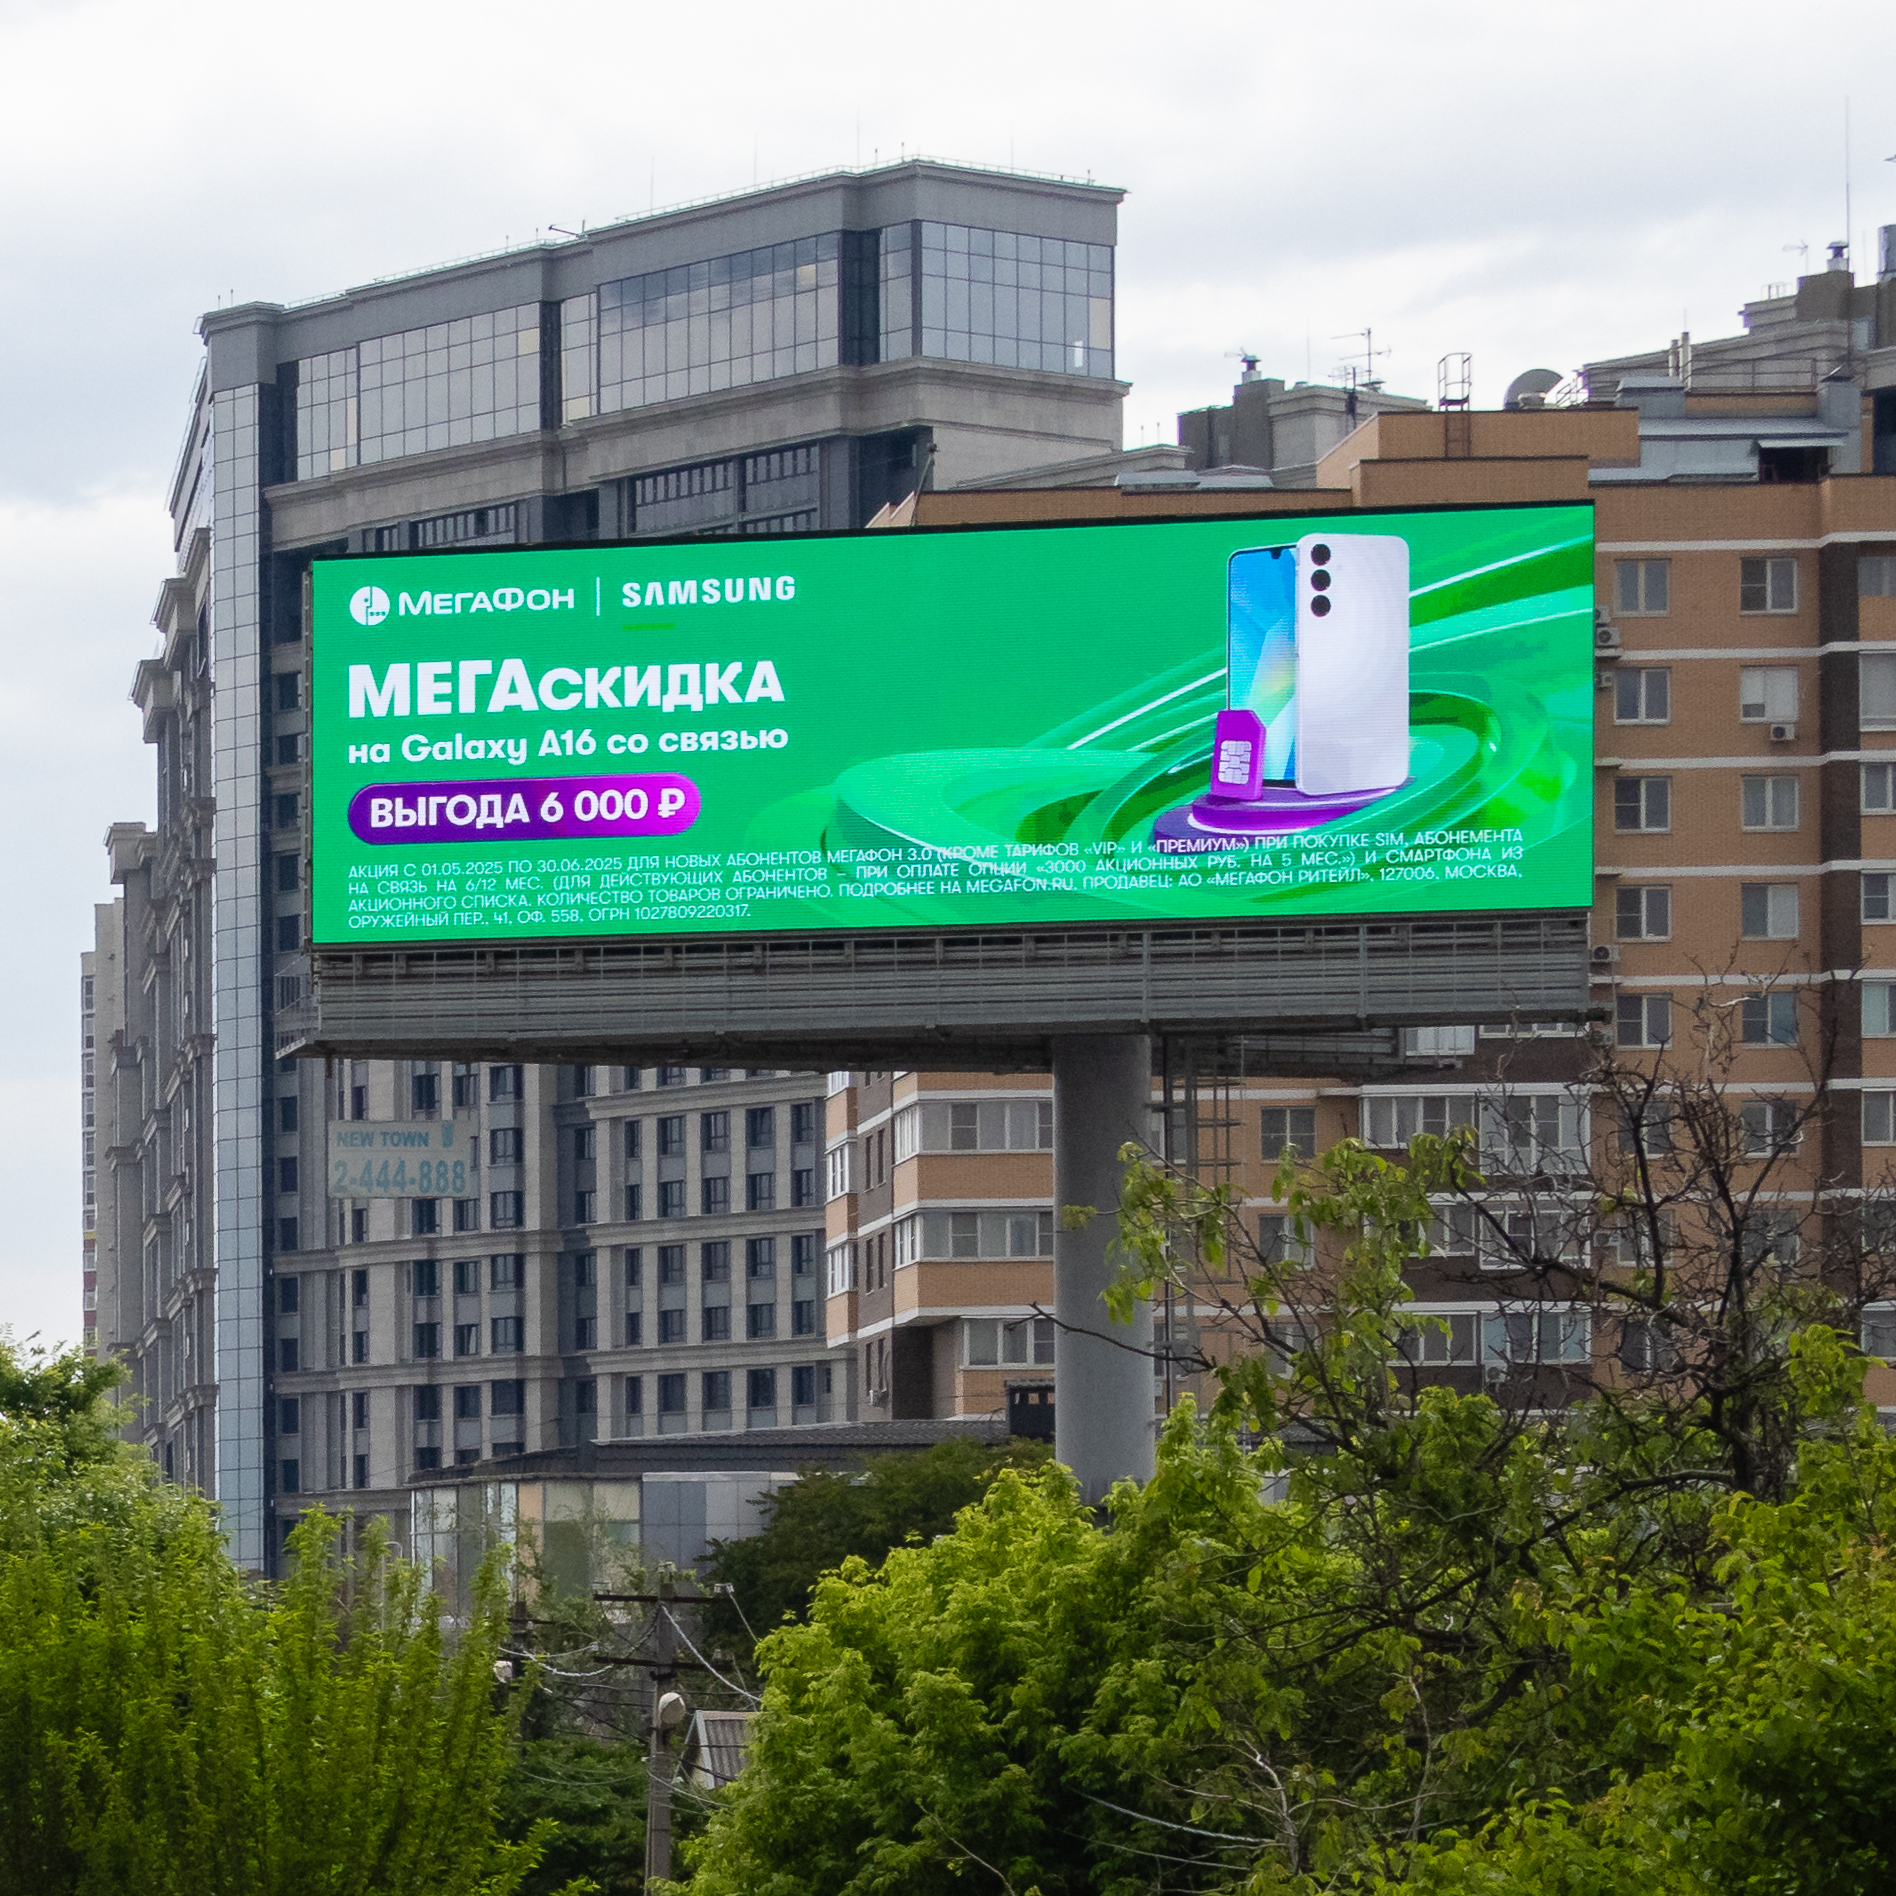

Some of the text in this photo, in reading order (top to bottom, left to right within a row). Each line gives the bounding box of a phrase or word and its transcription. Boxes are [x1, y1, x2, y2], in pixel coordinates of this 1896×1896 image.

[622, 575, 795, 608] SAMSUNG
[348, 658, 785, 718] МЕГАСКИДКА
[348, 728, 789, 765] на Galaxy A16 со связью
[370, 793, 529, 829] ВЫГОДА
[540, 794, 564, 823] 6
[573, 789, 648, 822] 000
[348, 864, 398, 879] АКЦИЯ
[404, 864, 416, 877] С
[421, 862, 503, 876] 01.05.2025
[508, 861, 533, 874] ПО
[537, 857, 622, 873] 30.06.2025
[626, 856, 660, 871] ДЛЯ
[665, 854, 721, 869] НОВЫХ
[726, 850, 822, 866] АБОНЕНТОВ
[827, 848, 903, 864] МЕГАФОН
[908, 847, 932, 861] 3.0
[937, 845, 999, 863] (КРОМЕ
[1006, 842, 1079, 858] ТАРИФОВ
[1131, 840, 1142, 853] И
[1147, 836, 1250, 854] «ПРЕМИУМ»)
[1255, 835, 1288, 849] ПРИ
[1293, 833, 1369, 849] ПОКУПКЕ
[1375, 832, 1409, 848] SIM,
[1414, 828, 1523, 845] АБОНЕМЕНТА
[348, 881, 369, 894] НА
[377, 879, 427, 893] СВЯЗЬ
[436, 878, 457, 892] НА
[465, 877, 496, 892] 6/12
[505, 876, 544, 891] МЕС.
[553, 875, 590, 891] (ДЛЯ
[599, 871, 723, 889] ДЕЙСТВУЮЩИХ
[732, 867, 827, 883] АБОНЕНТОВ
[856, 864, 888, 879] ПРИ
[896, 862, 959, 878] ОПЛАТЕ
[968, 861, 1027, 878] ОПЦИИ
[1036, 859, 1087, 874] «3000
[1096, 856, 1198, 873] АКЦИОННЫХ
[1208, 853, 1241, 869] РУБ.
[1250, 852, 1273, 867] НА
[1281, 853, 1292, 867] 5
[1365, 850, 1376, 864] И
[1385, 847, 1491, 864] СМАРТФОНА
[1501, 846, 1523, 860] ИЗ
[348, 895, 457, 913] АКЦИОННОГО
[461, 893, 532, 909] СПИСКА.
[537, 890, 643, 907] КОЛИЧЕСТВО
[647, 888, 721, 903] ТОВАРОВ
[725, 884, 833, 900] ОГРАНИЧЕНО.
[839, 881, 935, 898] ПОДРОБНЕЕ
[940, 880, 962, 894] НА
[1083, 874, 1173, 890] ПРОДАВЕЦ:
[1178, 873, 1202, 887] АО
[1207, 870, 1293, 886] «МЕГАФОН
[348, 911, 449, 929] ОРУЖЕЙНЫЙ
[588, 907, 631, 922] ОГРН
[336, 1131, 429, 1147] NEW TOWN
[334, 1159, 466, 1194] 2-444-888
